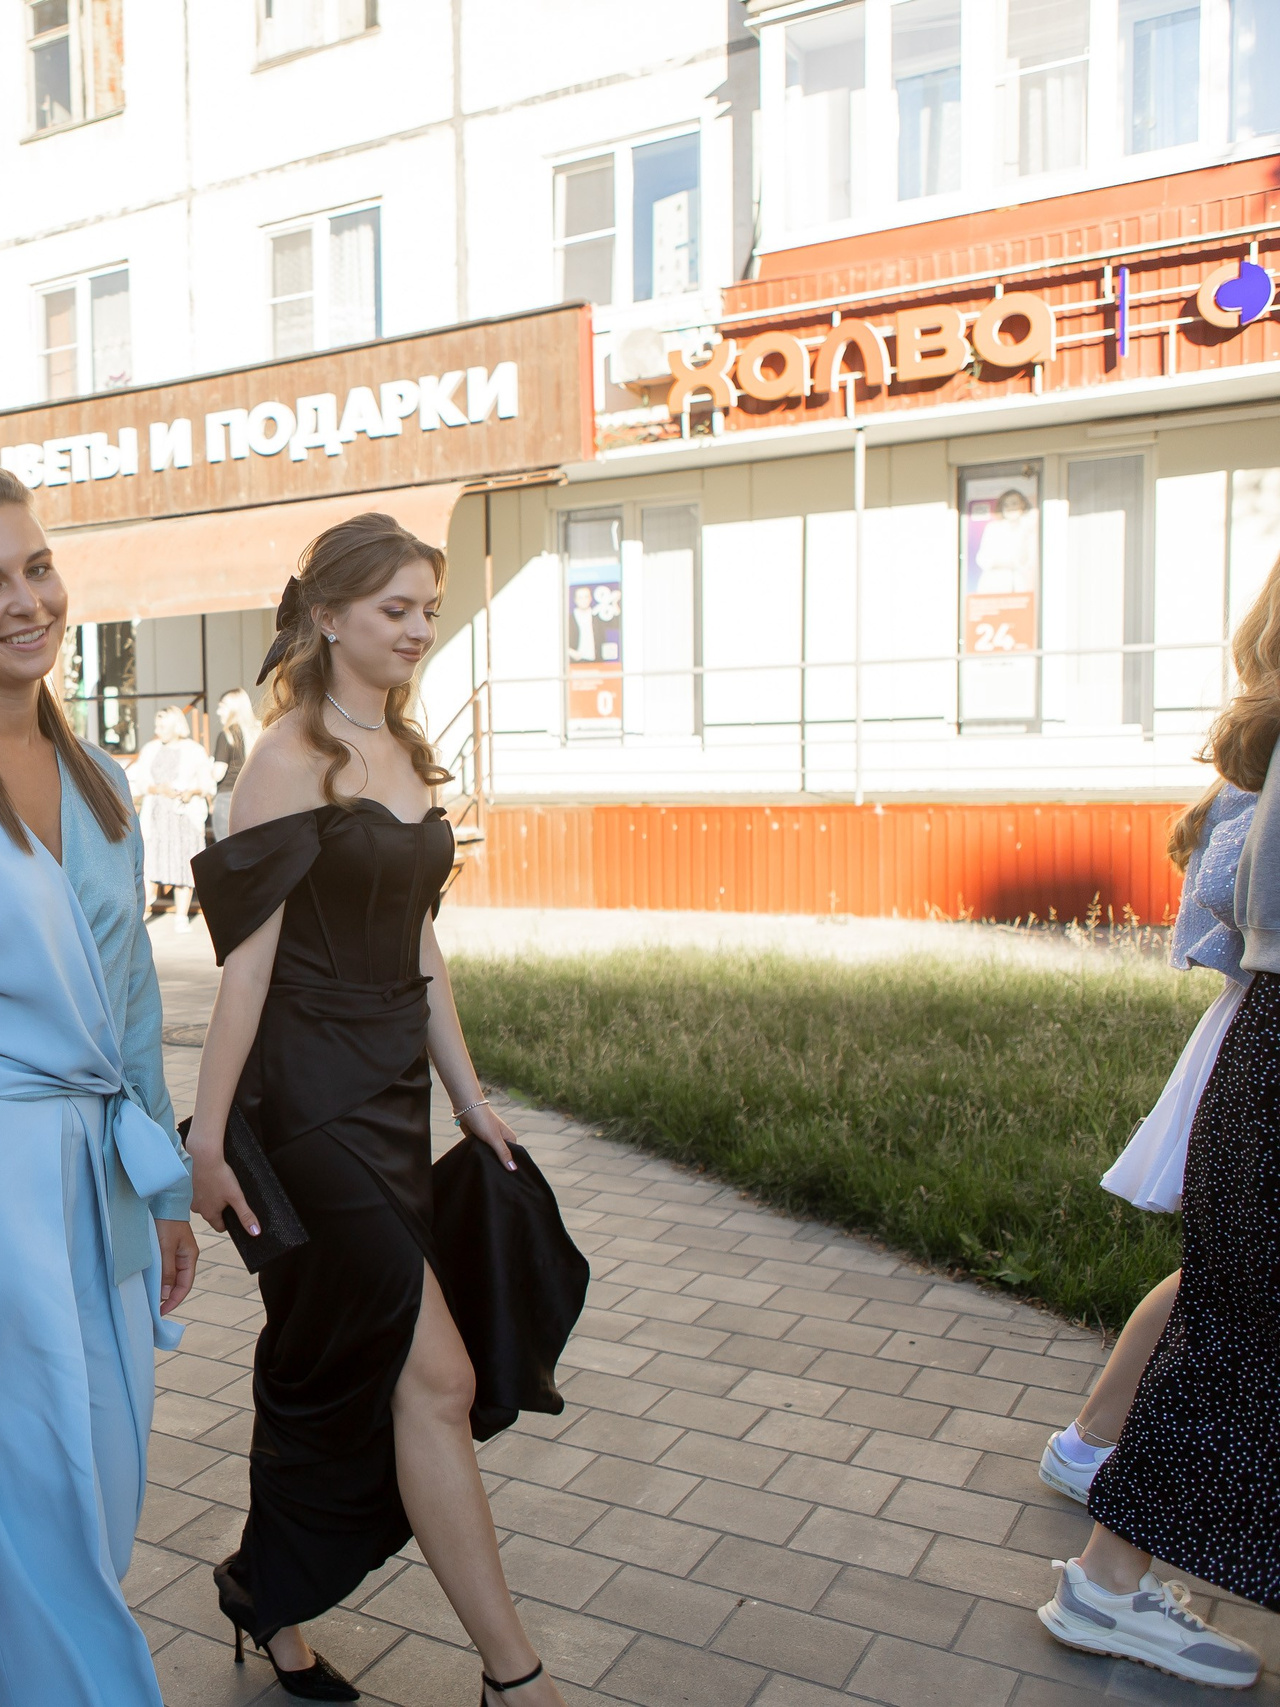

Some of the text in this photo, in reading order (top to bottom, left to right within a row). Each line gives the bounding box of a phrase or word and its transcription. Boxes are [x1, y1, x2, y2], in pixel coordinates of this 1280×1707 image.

[149, 417, 192, 472] И
[205, 361, 518, 463] ПОДАРКИ
[975, 623, 1016, 651] 24
